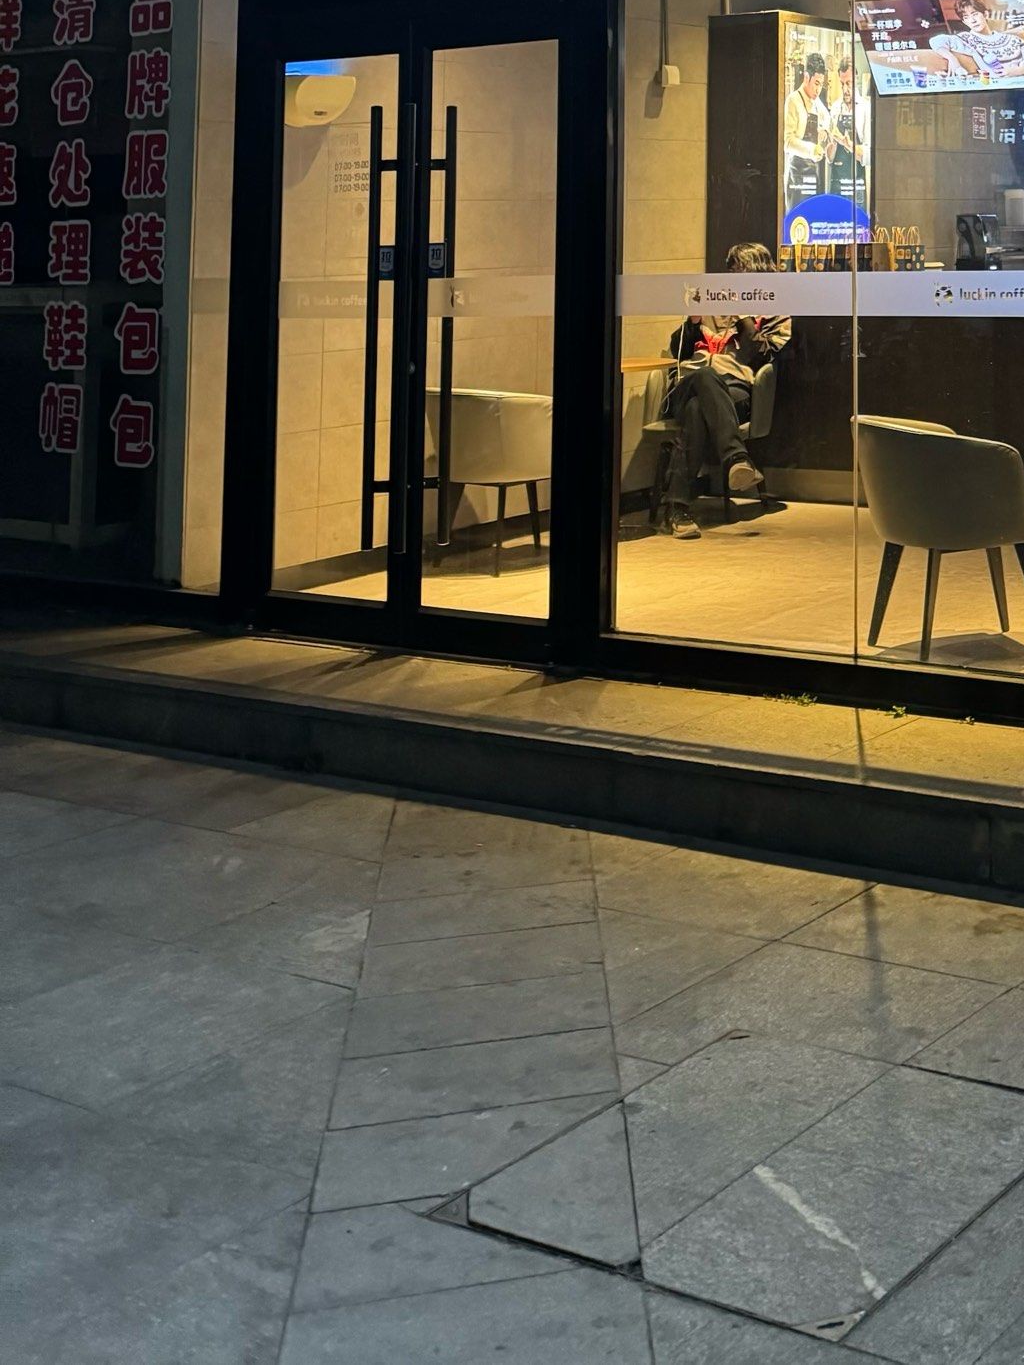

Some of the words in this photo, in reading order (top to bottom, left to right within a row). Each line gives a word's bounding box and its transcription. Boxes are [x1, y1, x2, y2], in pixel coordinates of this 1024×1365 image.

[706, 288, 738, 301] luckin
[741, 288, 775, 301] coffee
[959, 288, 996, 301] luckin
